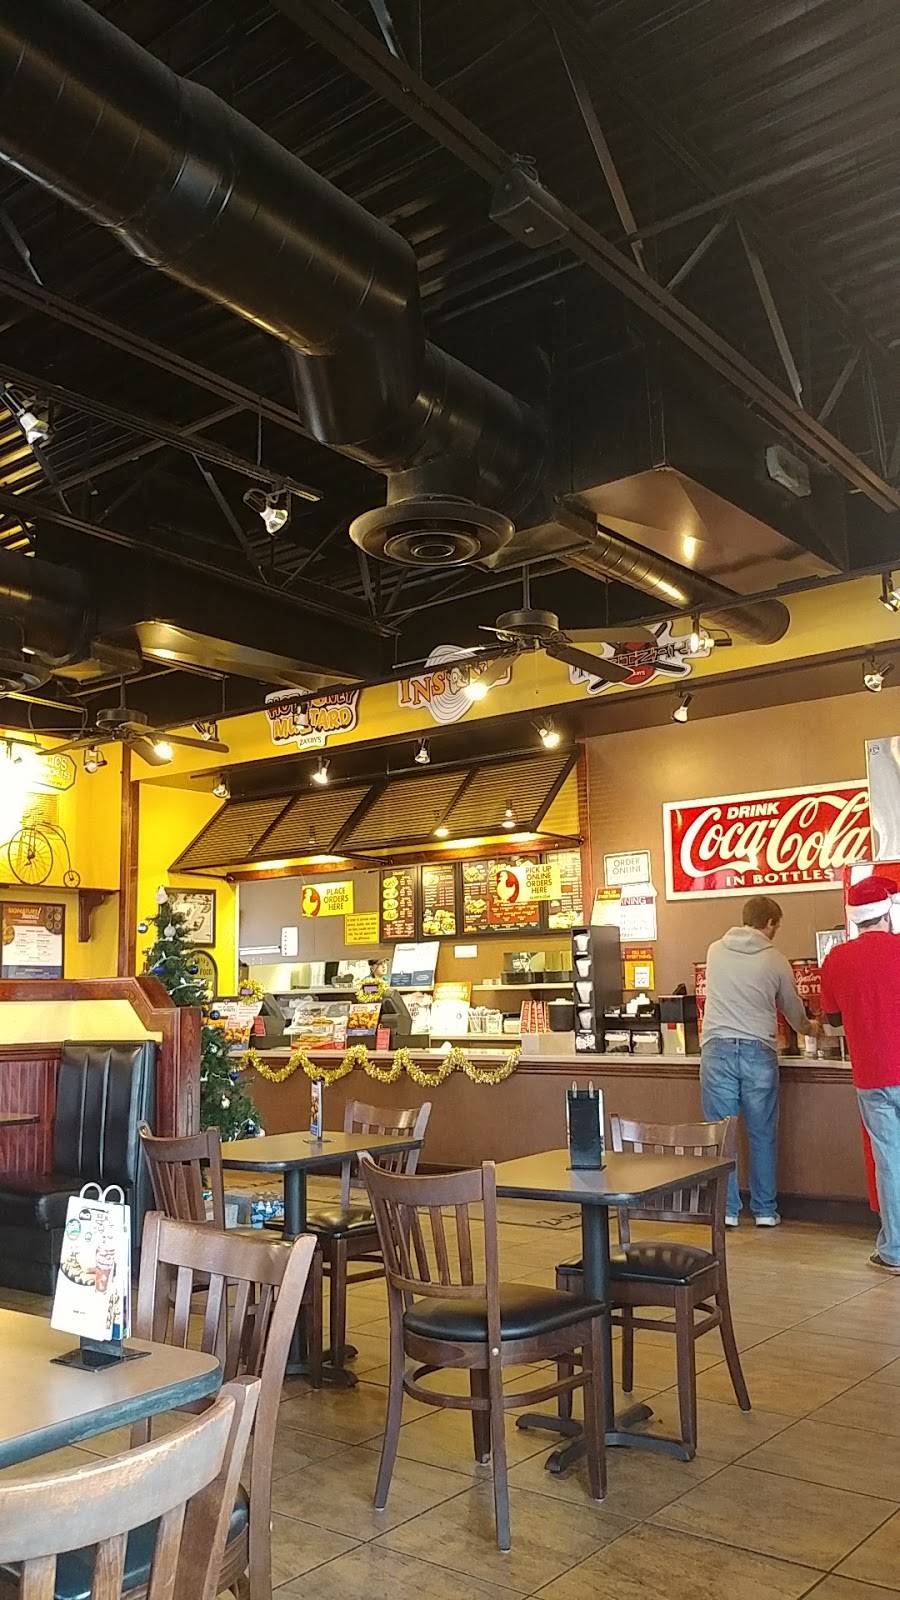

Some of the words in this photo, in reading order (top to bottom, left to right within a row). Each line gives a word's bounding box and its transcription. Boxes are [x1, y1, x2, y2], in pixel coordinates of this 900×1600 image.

[726, 801, 781, 821] DRINK
[680, 790, 871, 878] Coca-Cola
[613, 857, 641, 868] ORDER
[526, 872, 552, 880] ONLINE
[725, 874, 746, 887] IN
[752, 868, 835, 885] BOTTLES
[526, 879, 553, 888] ORDERS
[326, 887, 346, 895] PLACE
[323, 894, 349, 904] ORDERS
[328, 903, 344, 911] HERE
